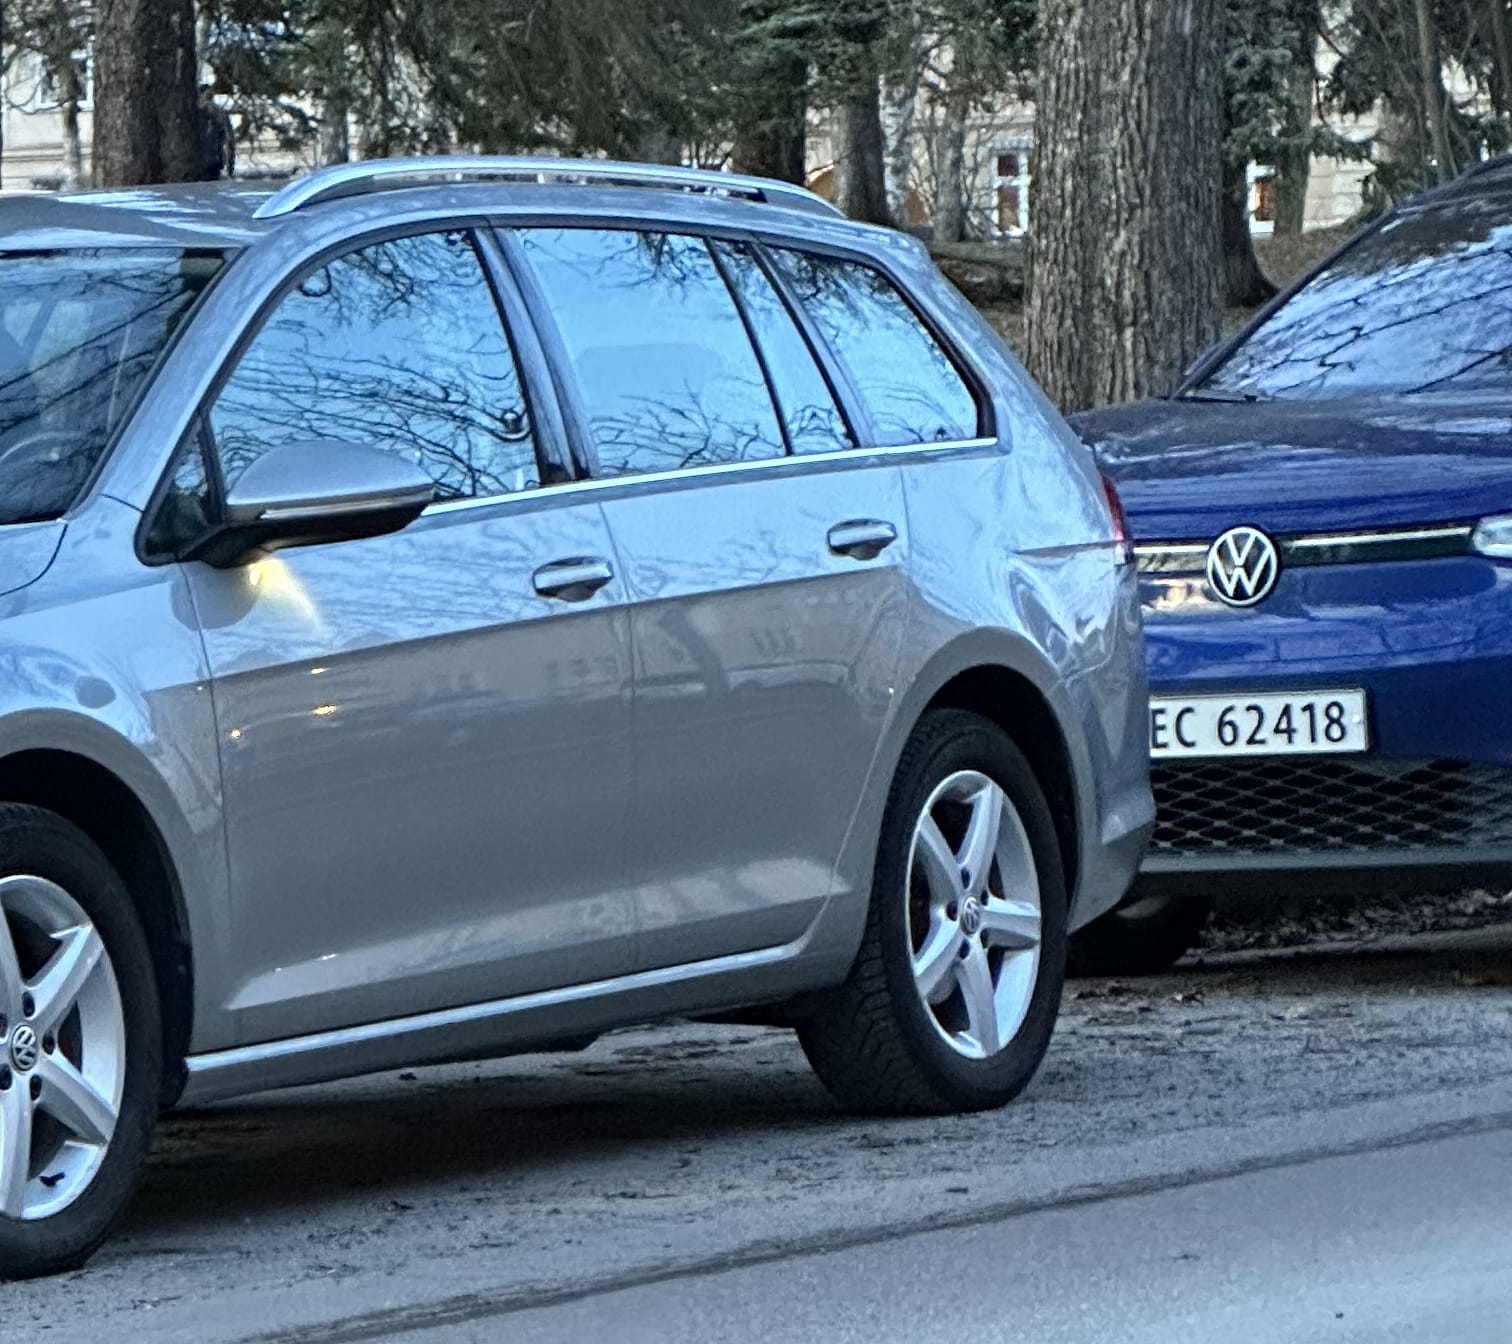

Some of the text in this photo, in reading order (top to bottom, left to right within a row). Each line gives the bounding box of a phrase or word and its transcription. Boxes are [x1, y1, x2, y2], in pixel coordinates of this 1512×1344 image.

[1207, 527, 1278, 606] VW
[1151, 701, 1346, 749] EC 62418
